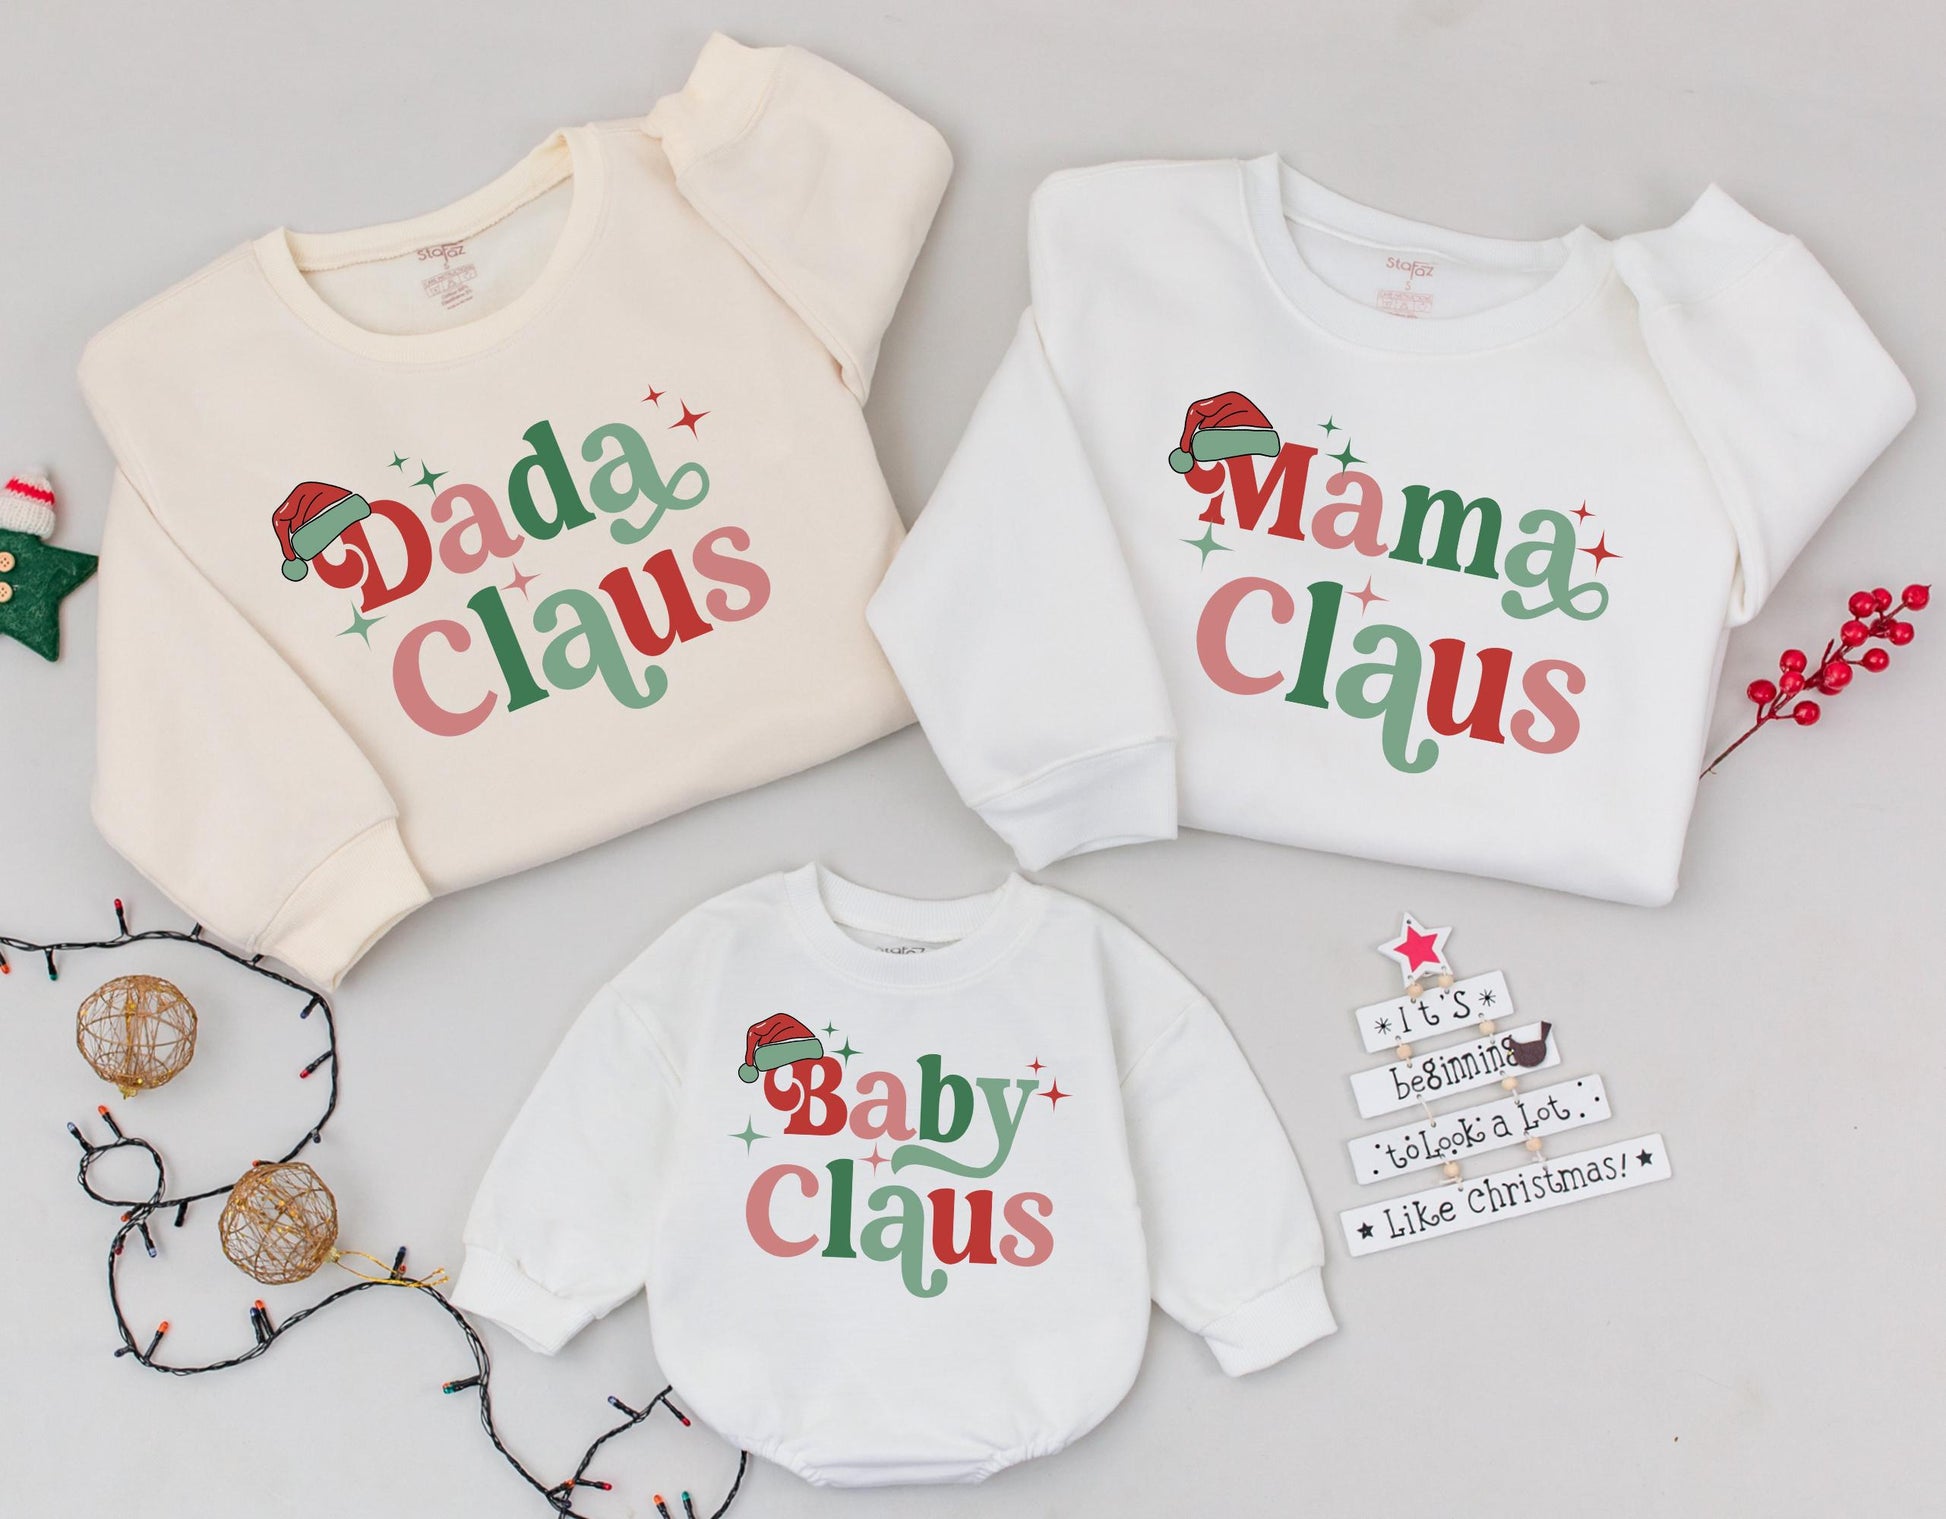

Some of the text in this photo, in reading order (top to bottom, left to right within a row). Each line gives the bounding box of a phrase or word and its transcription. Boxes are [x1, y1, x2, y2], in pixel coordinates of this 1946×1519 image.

[310, 419, 710, 614] Dada
[1183, 441, 1610, 622] Mama
[392, 525, 771, 738] Claus
[1195, 576, 1587, 775] Claus
[763, 1053, 1040, 1179] Baby
[1492, 1114, 1513, 1138] a
[1517, 1095, 1571, 1131] Lot
[745, 1158, 1055, 1299] Claus
[1383, 1200, 1457, 1240] Like
